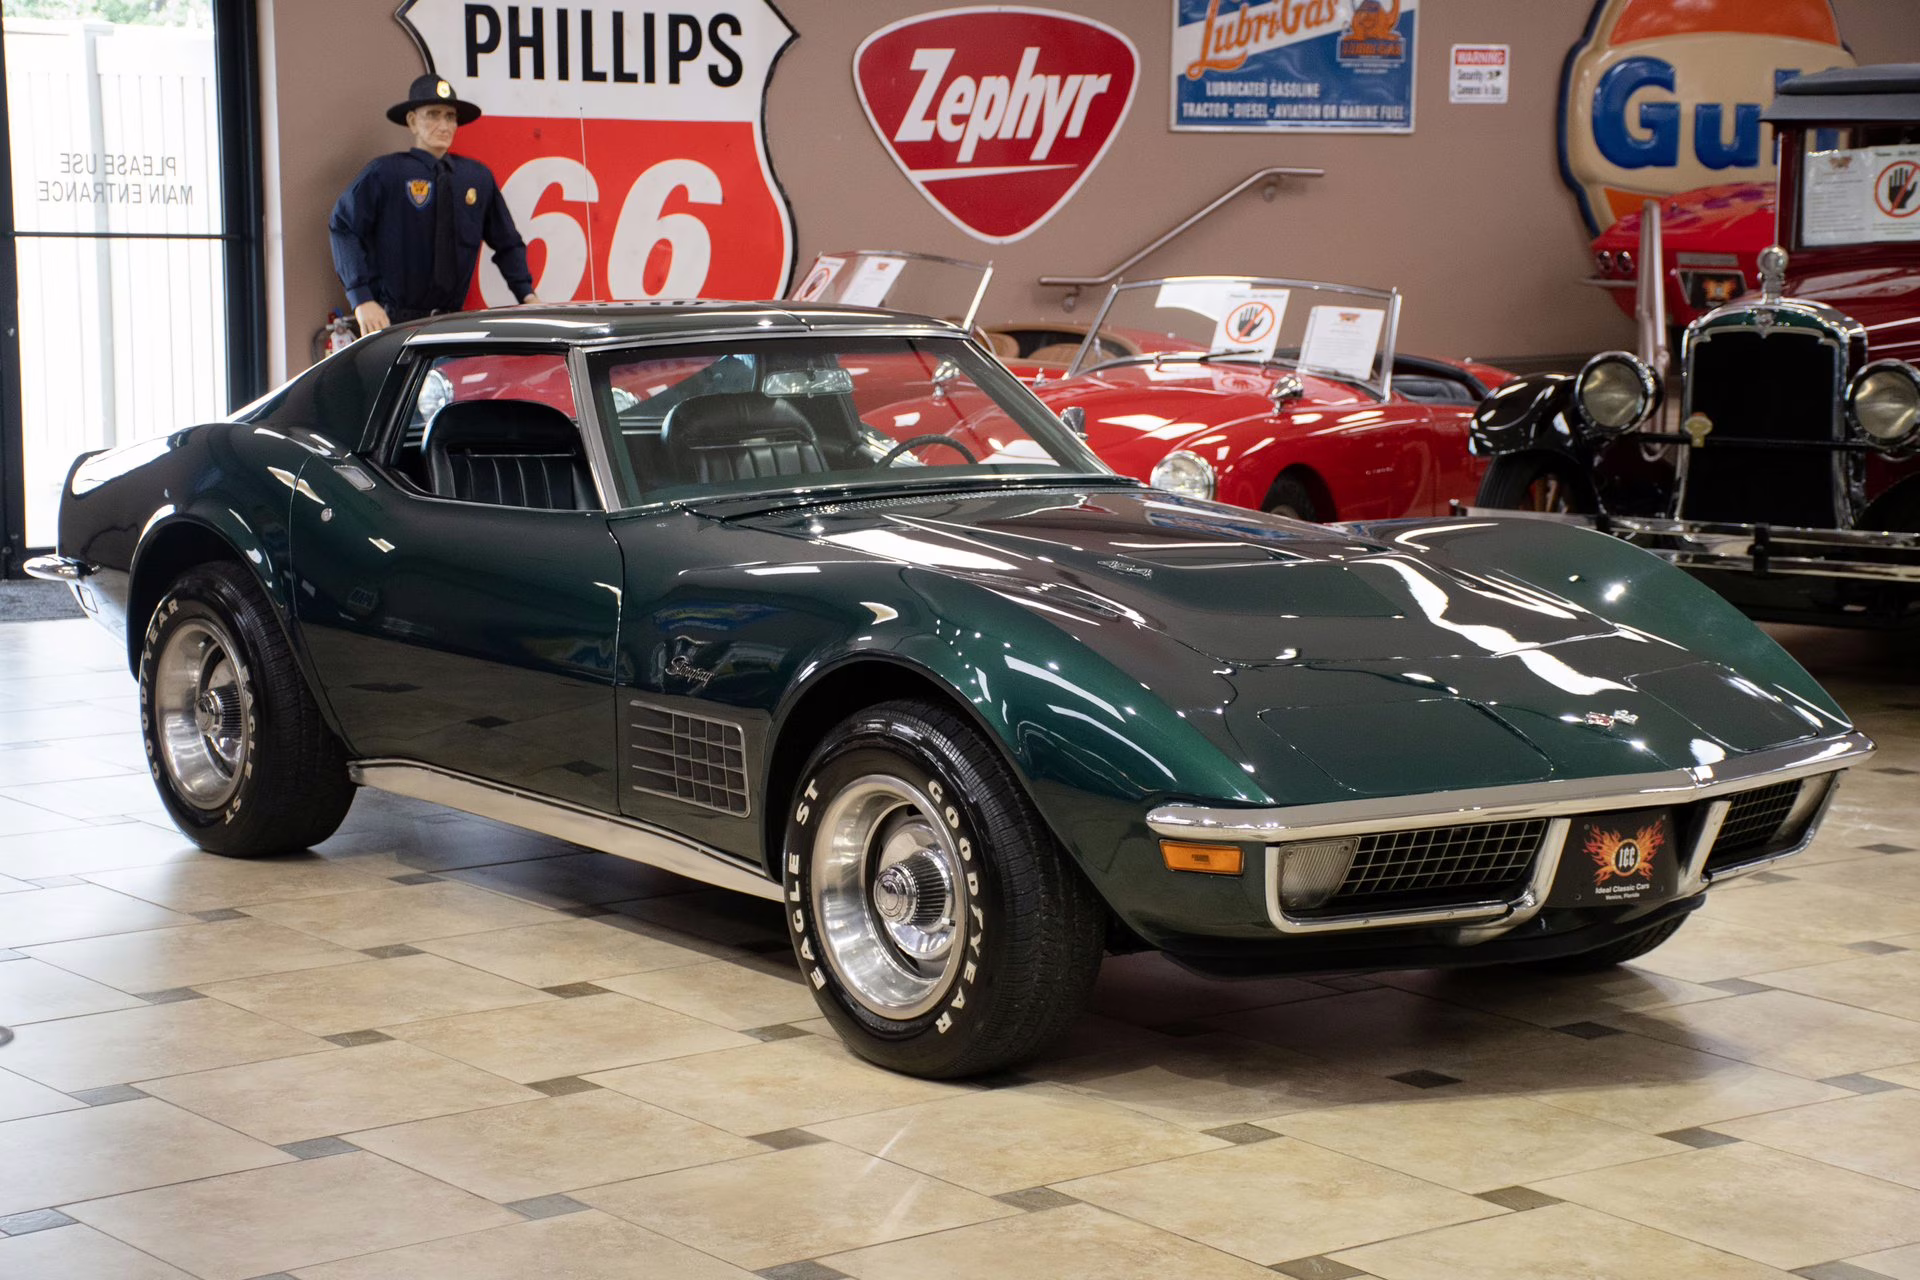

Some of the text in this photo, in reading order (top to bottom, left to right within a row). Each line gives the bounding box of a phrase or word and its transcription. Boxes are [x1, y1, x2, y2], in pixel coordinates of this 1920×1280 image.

[464, 3, 743, 88] PHILLIPS
[1457, 51, 1505, 65] WARNING
[1206, 81, 1320, 98] LUBRICATED GASOLINE
[1457, 68, 1483, 83] Security
[893, 46, 1112, 163] Zephyr
[1182, 102, 1404, 119] TRACTOR DIESEL AVIATION OR MARINE FUEL
[1592, 56, 1802, 170] Gu
[477, 156, 724, 308] 66
[664, 655, 716, 688] Stingray
[1618, 845, 1636, 868] ICC
[788, 779, 827, 991] EAGLE ST
[1595, 886, 1612, 894] Ideal
[1612, 885, 1636, 893] Classic
[928, 779, 985, 1035] GOODYEAR
